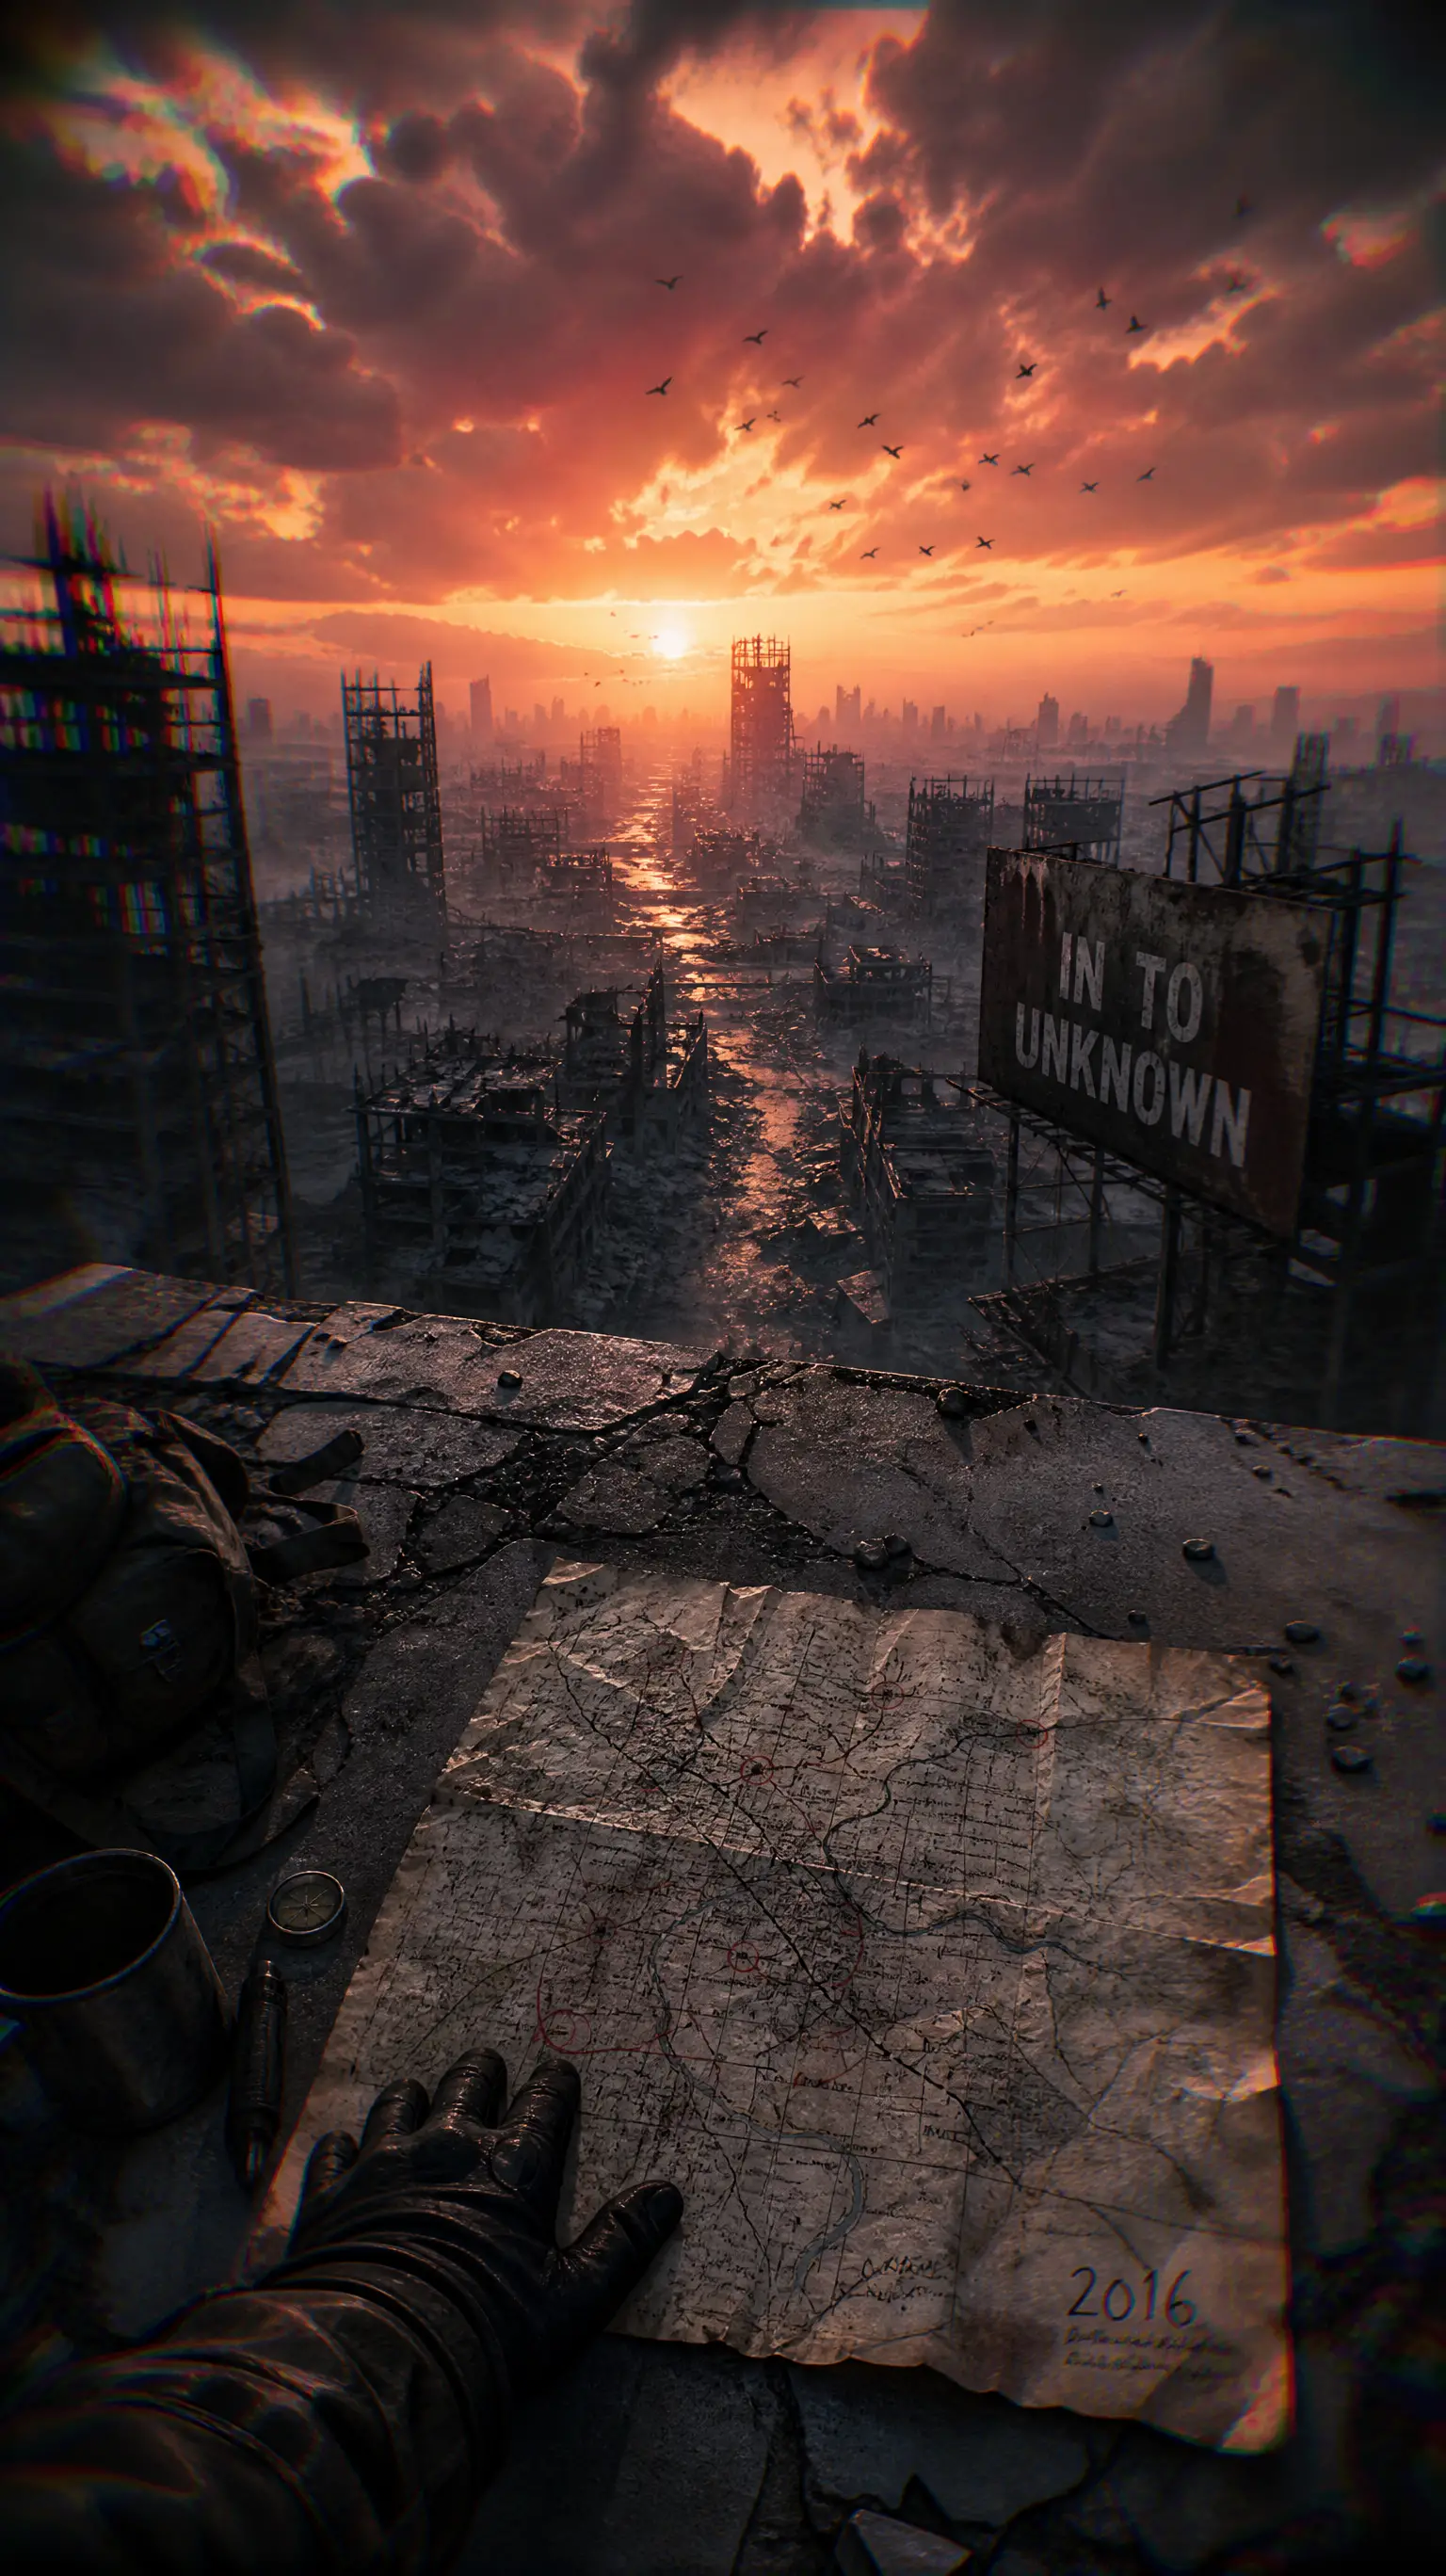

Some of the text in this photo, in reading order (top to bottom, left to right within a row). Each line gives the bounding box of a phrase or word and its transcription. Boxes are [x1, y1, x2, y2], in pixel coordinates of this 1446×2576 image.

[1059, 931, 1203, 1043] IN TO
[1015, 1002, 1253, 1168] UNKNOWN
[1067, 2266, 1197, 2329] 2016
